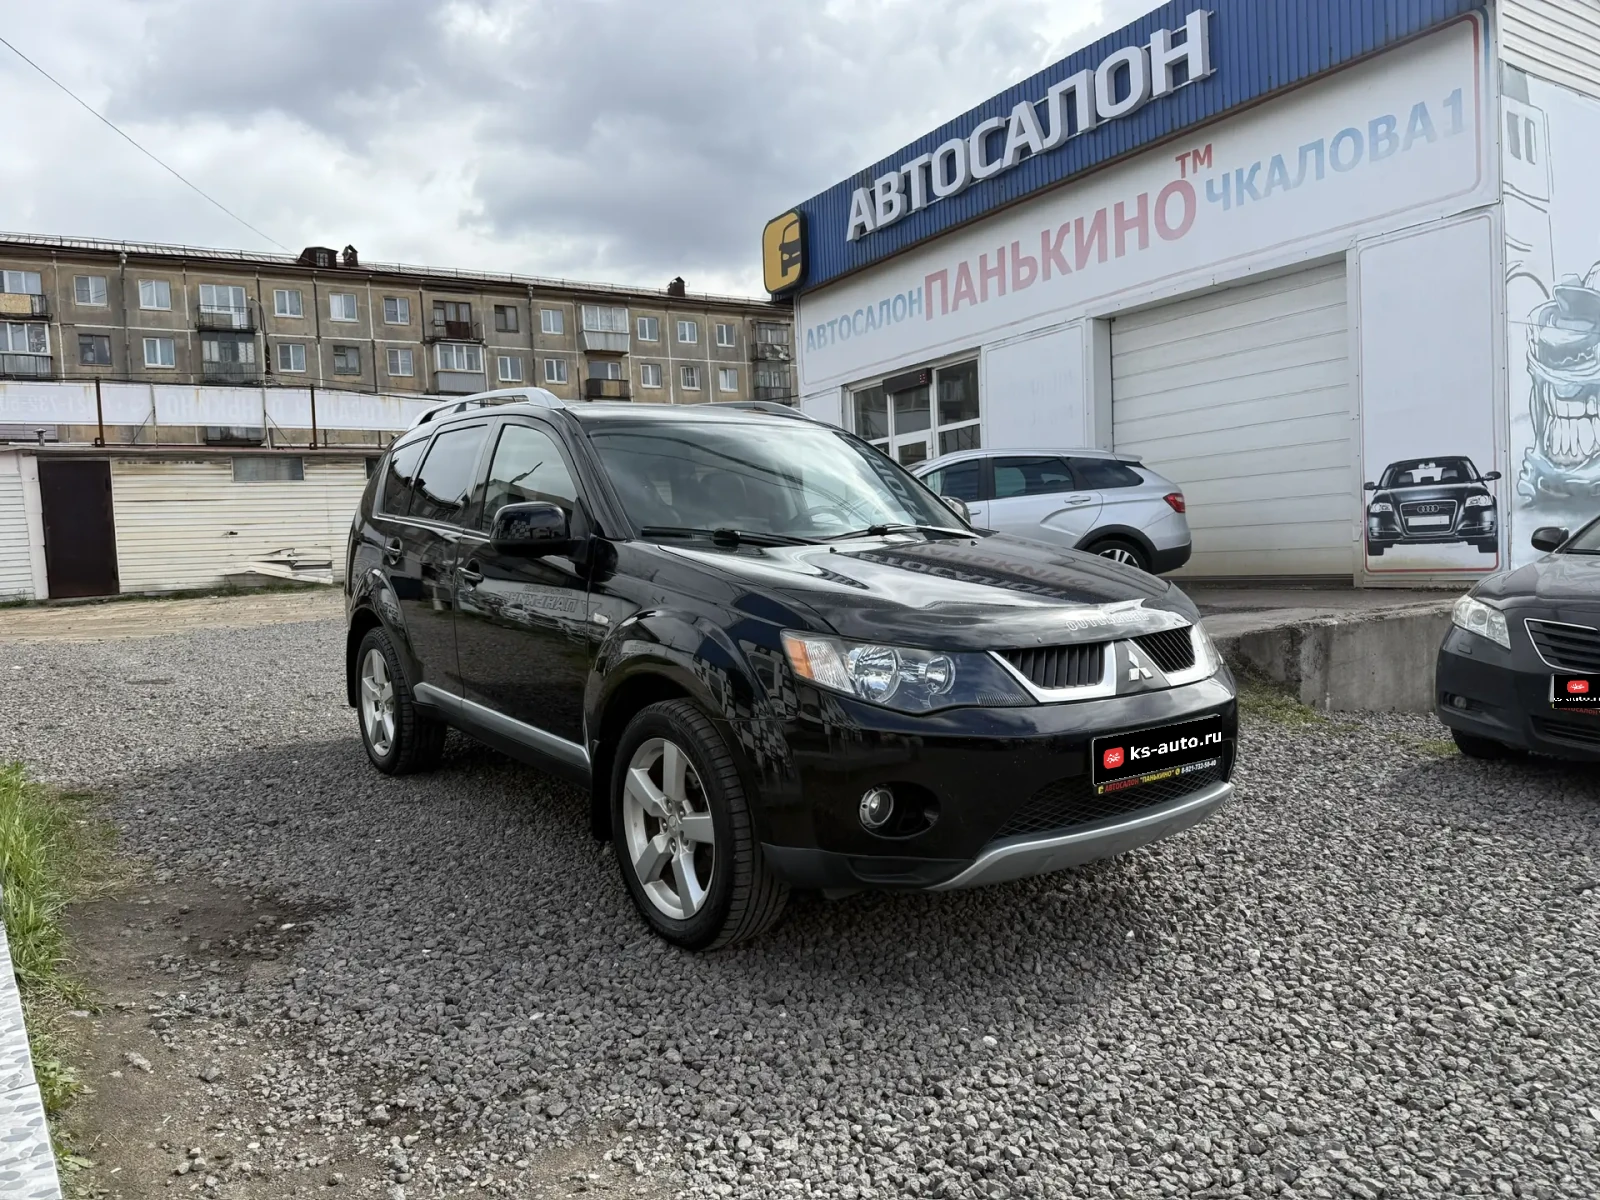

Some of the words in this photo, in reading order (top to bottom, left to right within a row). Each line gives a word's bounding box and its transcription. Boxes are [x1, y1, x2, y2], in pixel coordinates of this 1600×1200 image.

[846, 9, 1211, 242] АВТОСАЛОН
[806, 286, 922, 353] АВТОСАЛОН
[925, 179, 1197, 321] ПАНЬКИНО
[1065, 610, 1150, 632] OUTLANDER
[1105, 777, 1140, 793] АВТОСАЛОН
